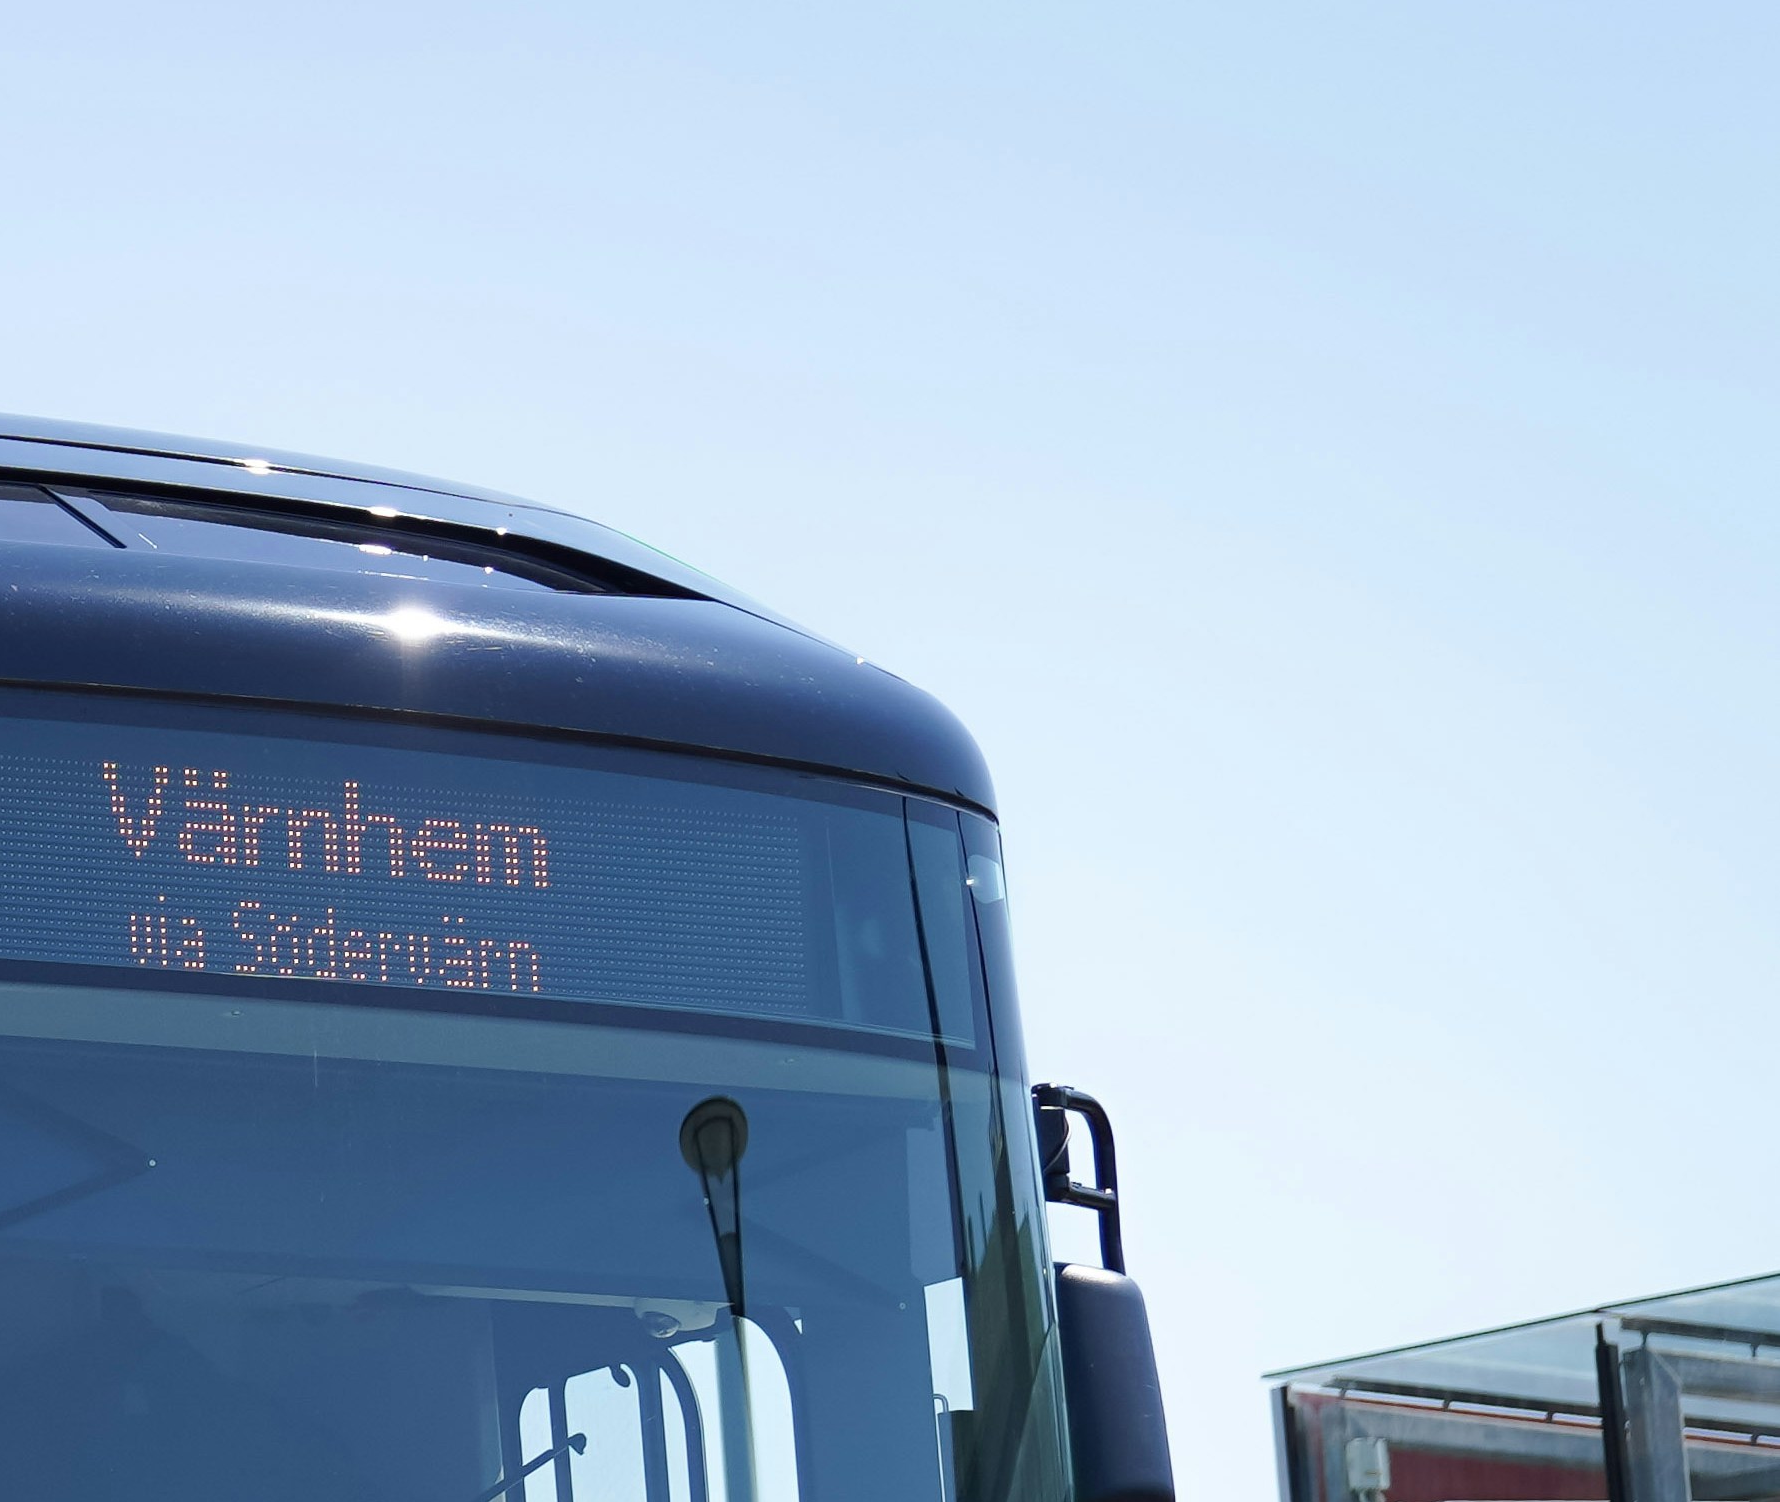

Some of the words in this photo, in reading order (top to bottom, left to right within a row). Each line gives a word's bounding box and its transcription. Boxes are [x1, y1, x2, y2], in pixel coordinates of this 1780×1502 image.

[101, 760, 550, 890] Värnhem
[128, 893, 207, 969] via
[231, 900, 542, 992] Södervärn
